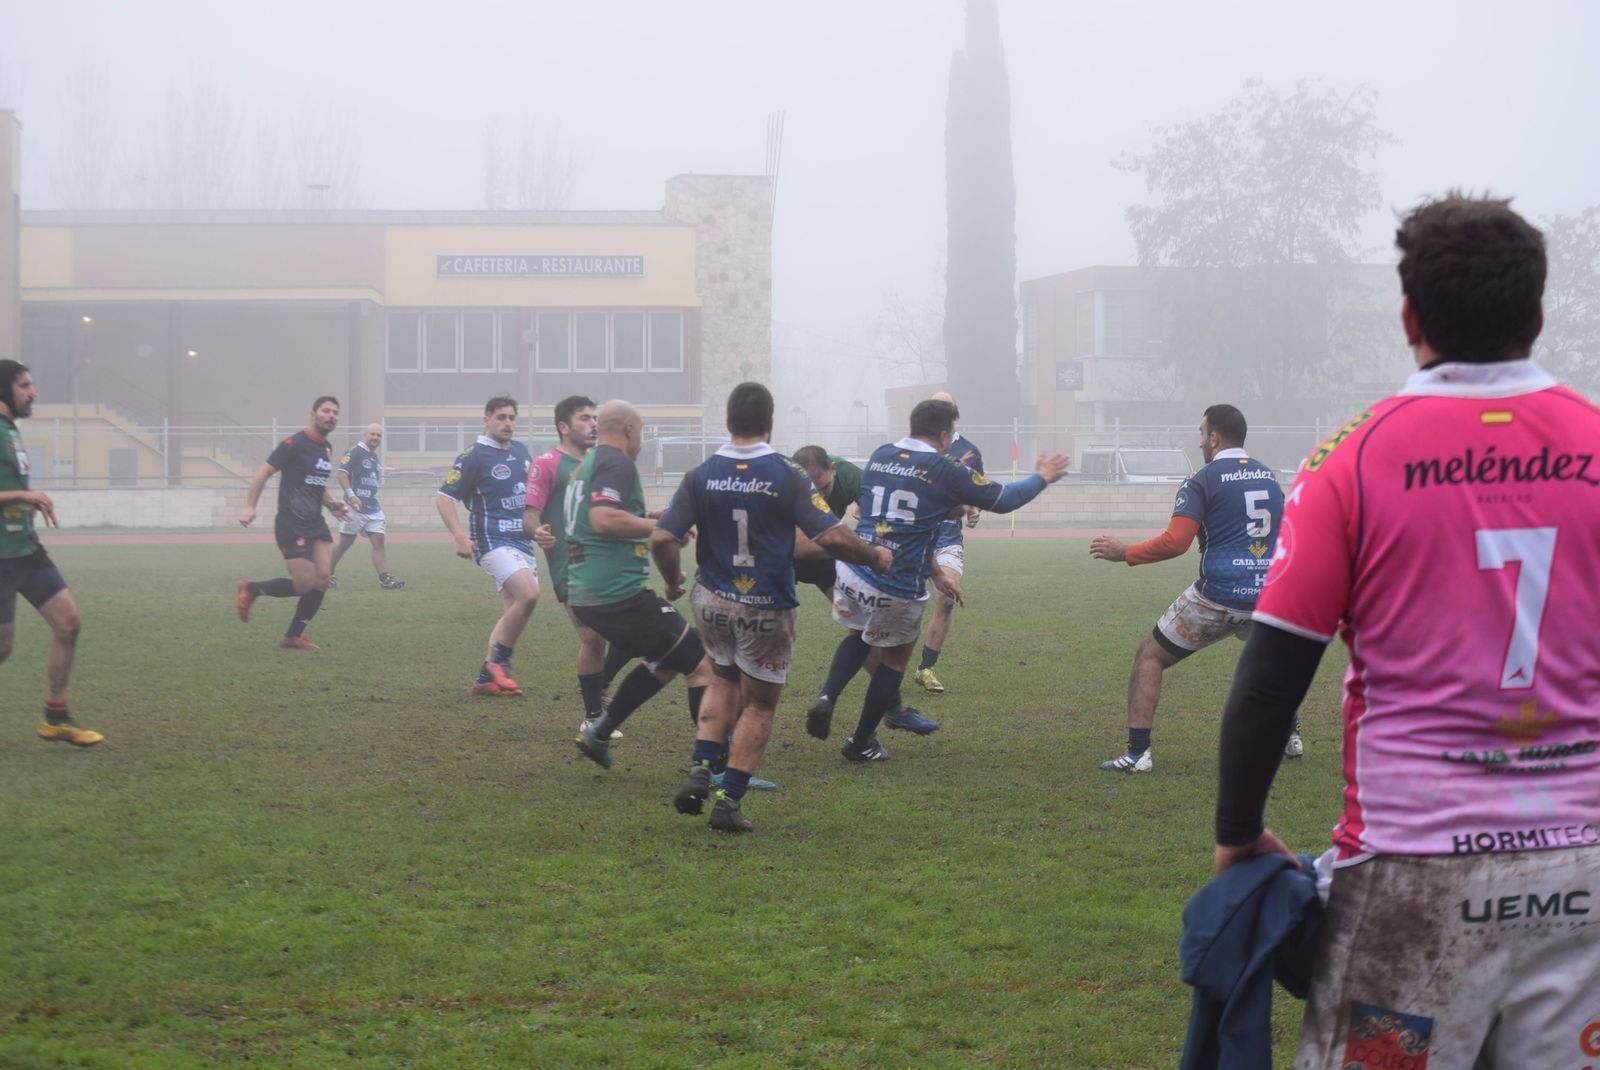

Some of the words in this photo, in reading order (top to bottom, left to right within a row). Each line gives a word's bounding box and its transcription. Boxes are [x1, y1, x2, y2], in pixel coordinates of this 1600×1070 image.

[453, 257, 529, 274] CAFETERIA
[542, 257, 641, 273] RESTAURANTE
[1404, 446, 1600, 491] meléndez
[870, 485, 919, 526] 16
[1244, 489, 1272, 538] 5
[732, 508, 755, 567] 1
[1475, 527, 1558, 689] 7
[1452, 824, 1600, 854] HORMITEC
[1461, 890, 1591, 924] UEMC
